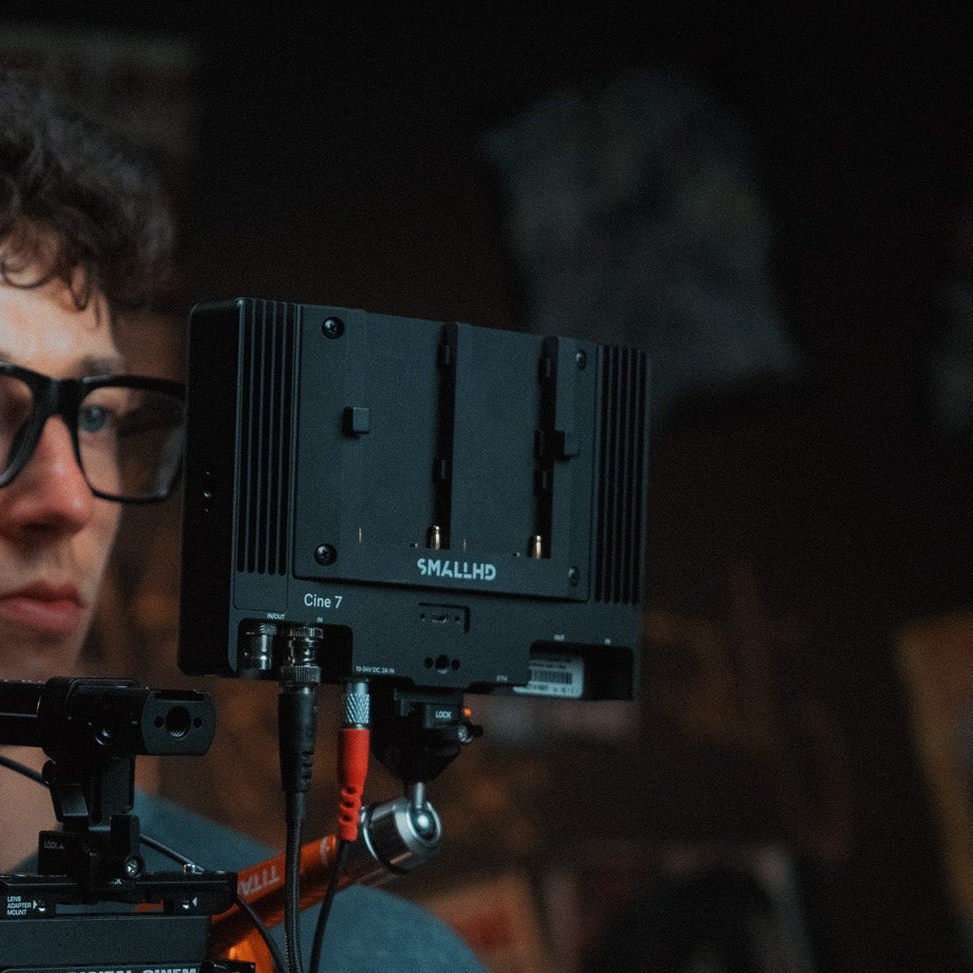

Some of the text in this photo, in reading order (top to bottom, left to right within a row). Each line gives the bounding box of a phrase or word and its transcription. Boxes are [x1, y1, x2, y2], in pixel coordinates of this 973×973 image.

[416, 557, 497, 581] SMALLHD
[303, 593, 343, 609] Cine 7
[6, 895, 22, 903] LENS
